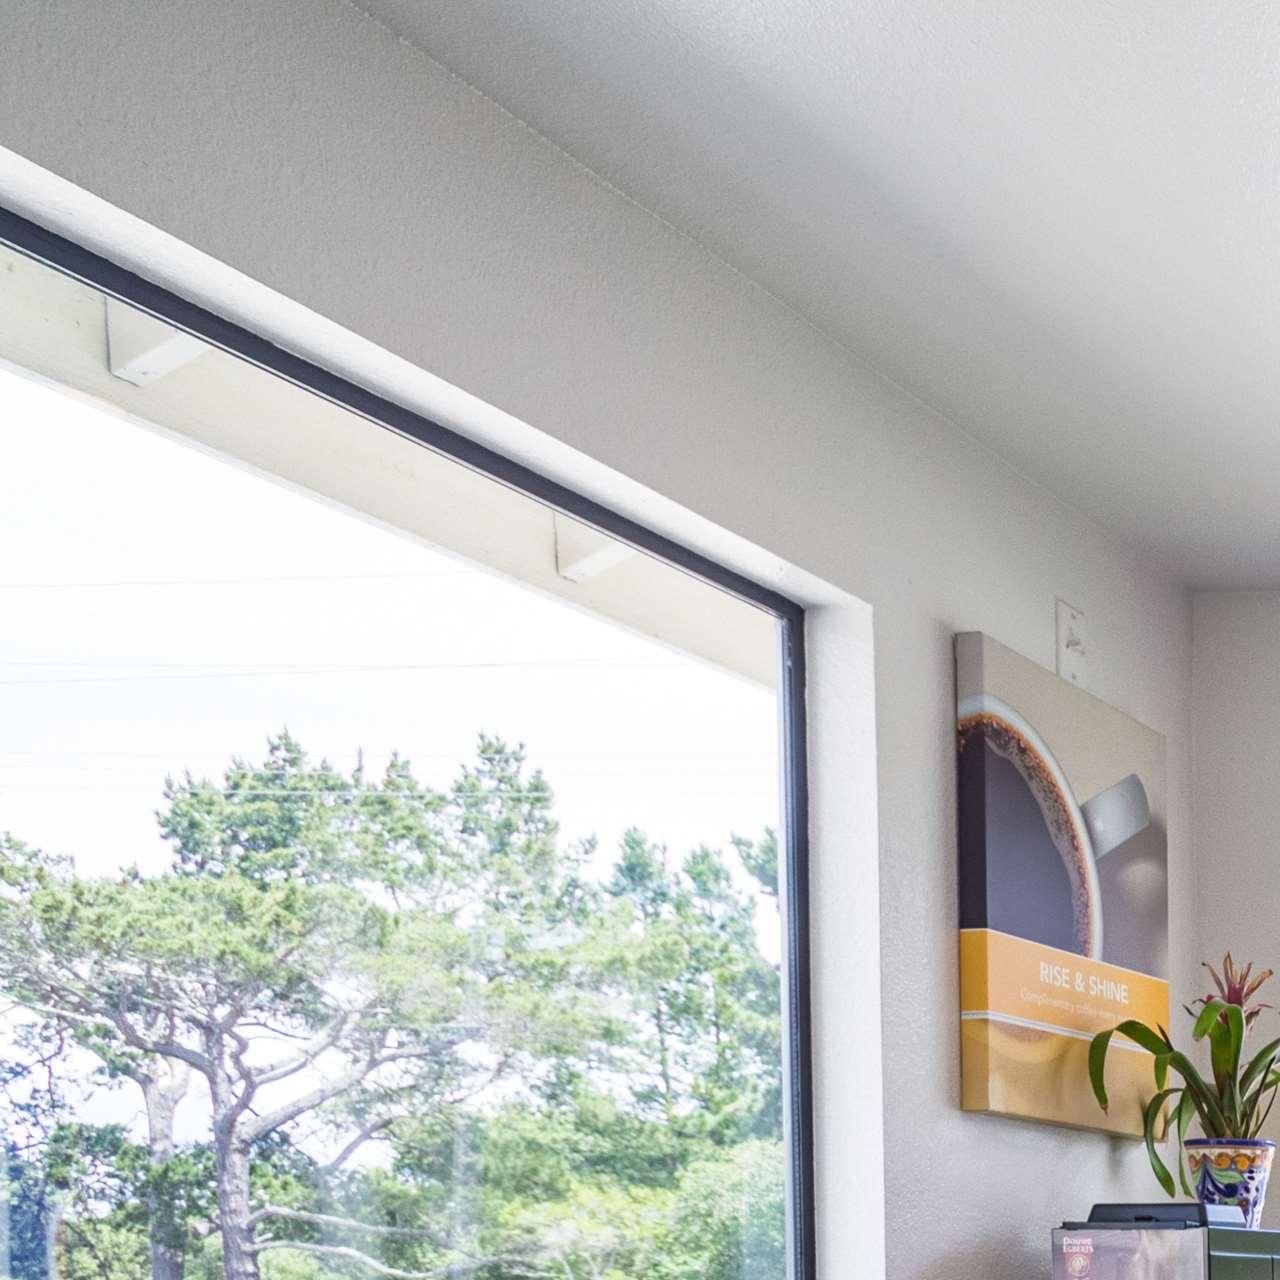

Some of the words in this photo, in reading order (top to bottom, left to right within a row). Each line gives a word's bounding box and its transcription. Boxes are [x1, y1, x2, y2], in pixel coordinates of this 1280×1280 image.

[1040, 962, 1070, 989] RISE
[1074, 971, 1086, 993] &
[1088, 976, 1128, 1005] SHINE
